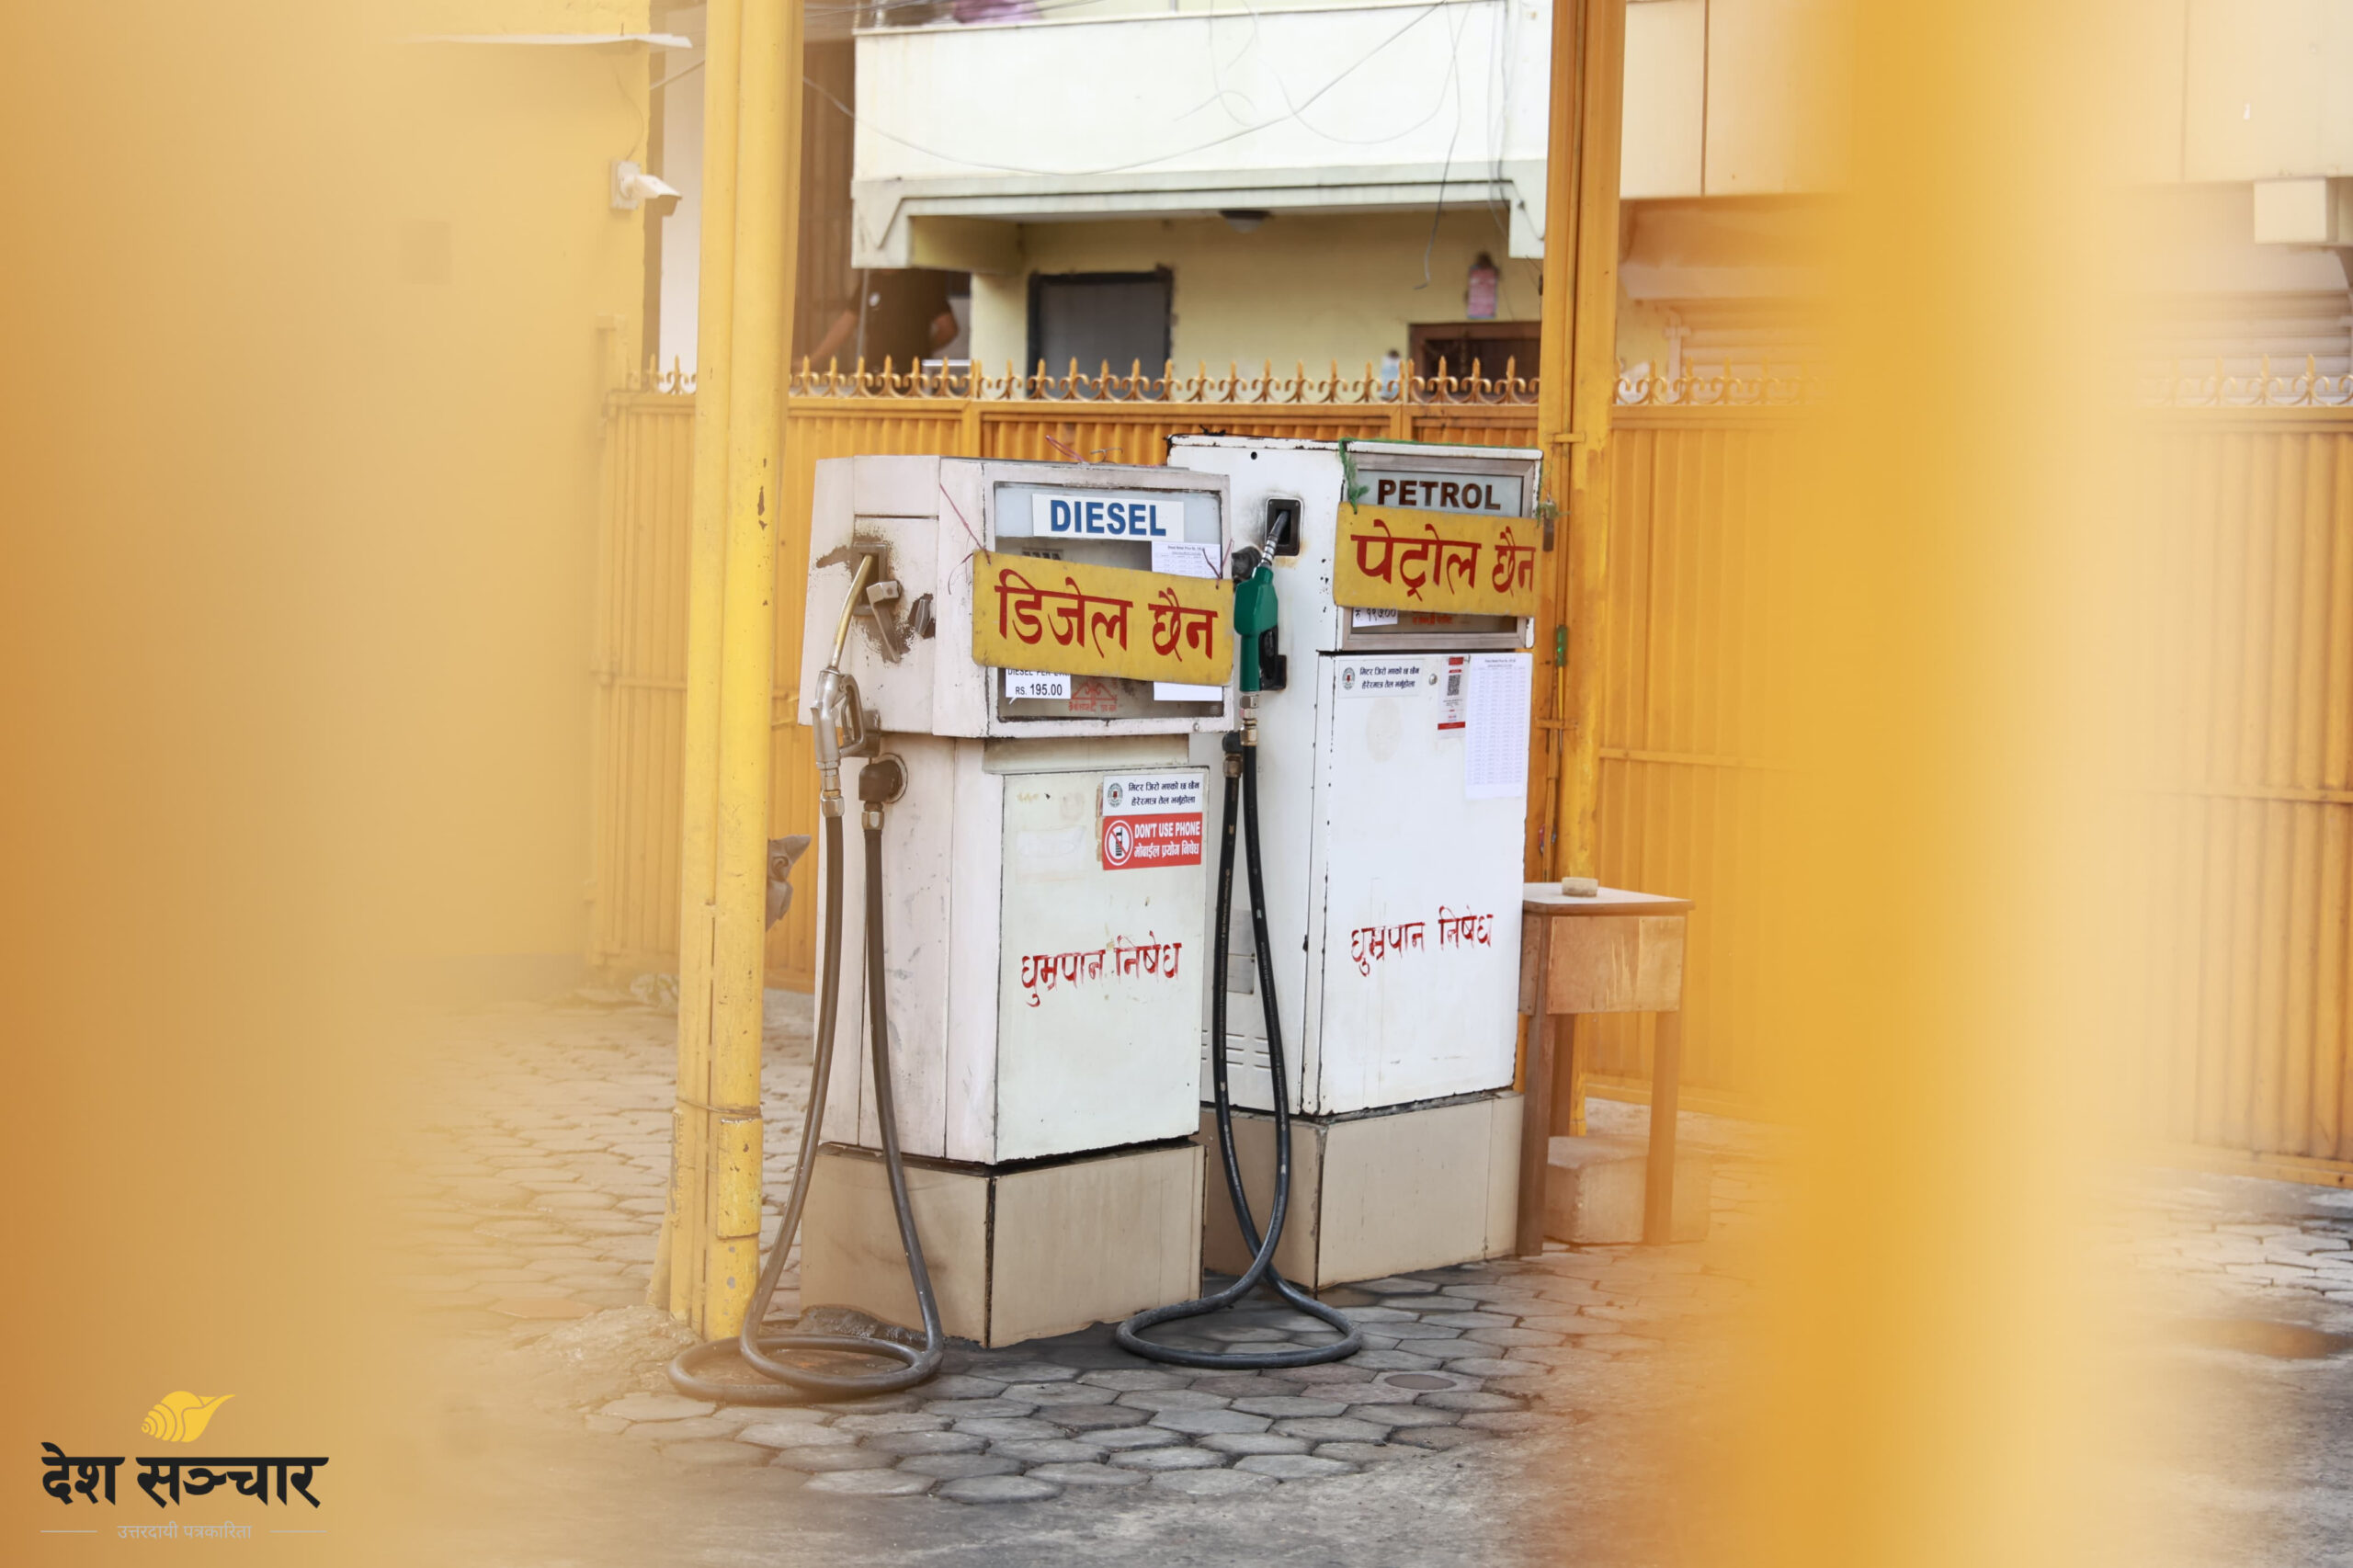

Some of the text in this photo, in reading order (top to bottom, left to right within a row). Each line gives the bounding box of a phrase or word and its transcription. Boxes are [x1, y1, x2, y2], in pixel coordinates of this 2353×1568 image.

[1377, 479, 1501, 510] PETROL
[1050, 499, 1166, 537] DIESEL
[1350, 518, 1537, 602] पेट्रोल छैन
[994, 568, 1219, 662] डिजेल छैन
[1015, 684, 1063, 696] RS. 195.00
[1158, 795, 1169, 804] तेल
[1134, 821, 1200, 839] DON'T USE PHONE
[1181, 840, 1199, 856] निषेध
[1438, 905, 1494, 950] निषेध
[1113, 930, 1182, 984] निषेध
